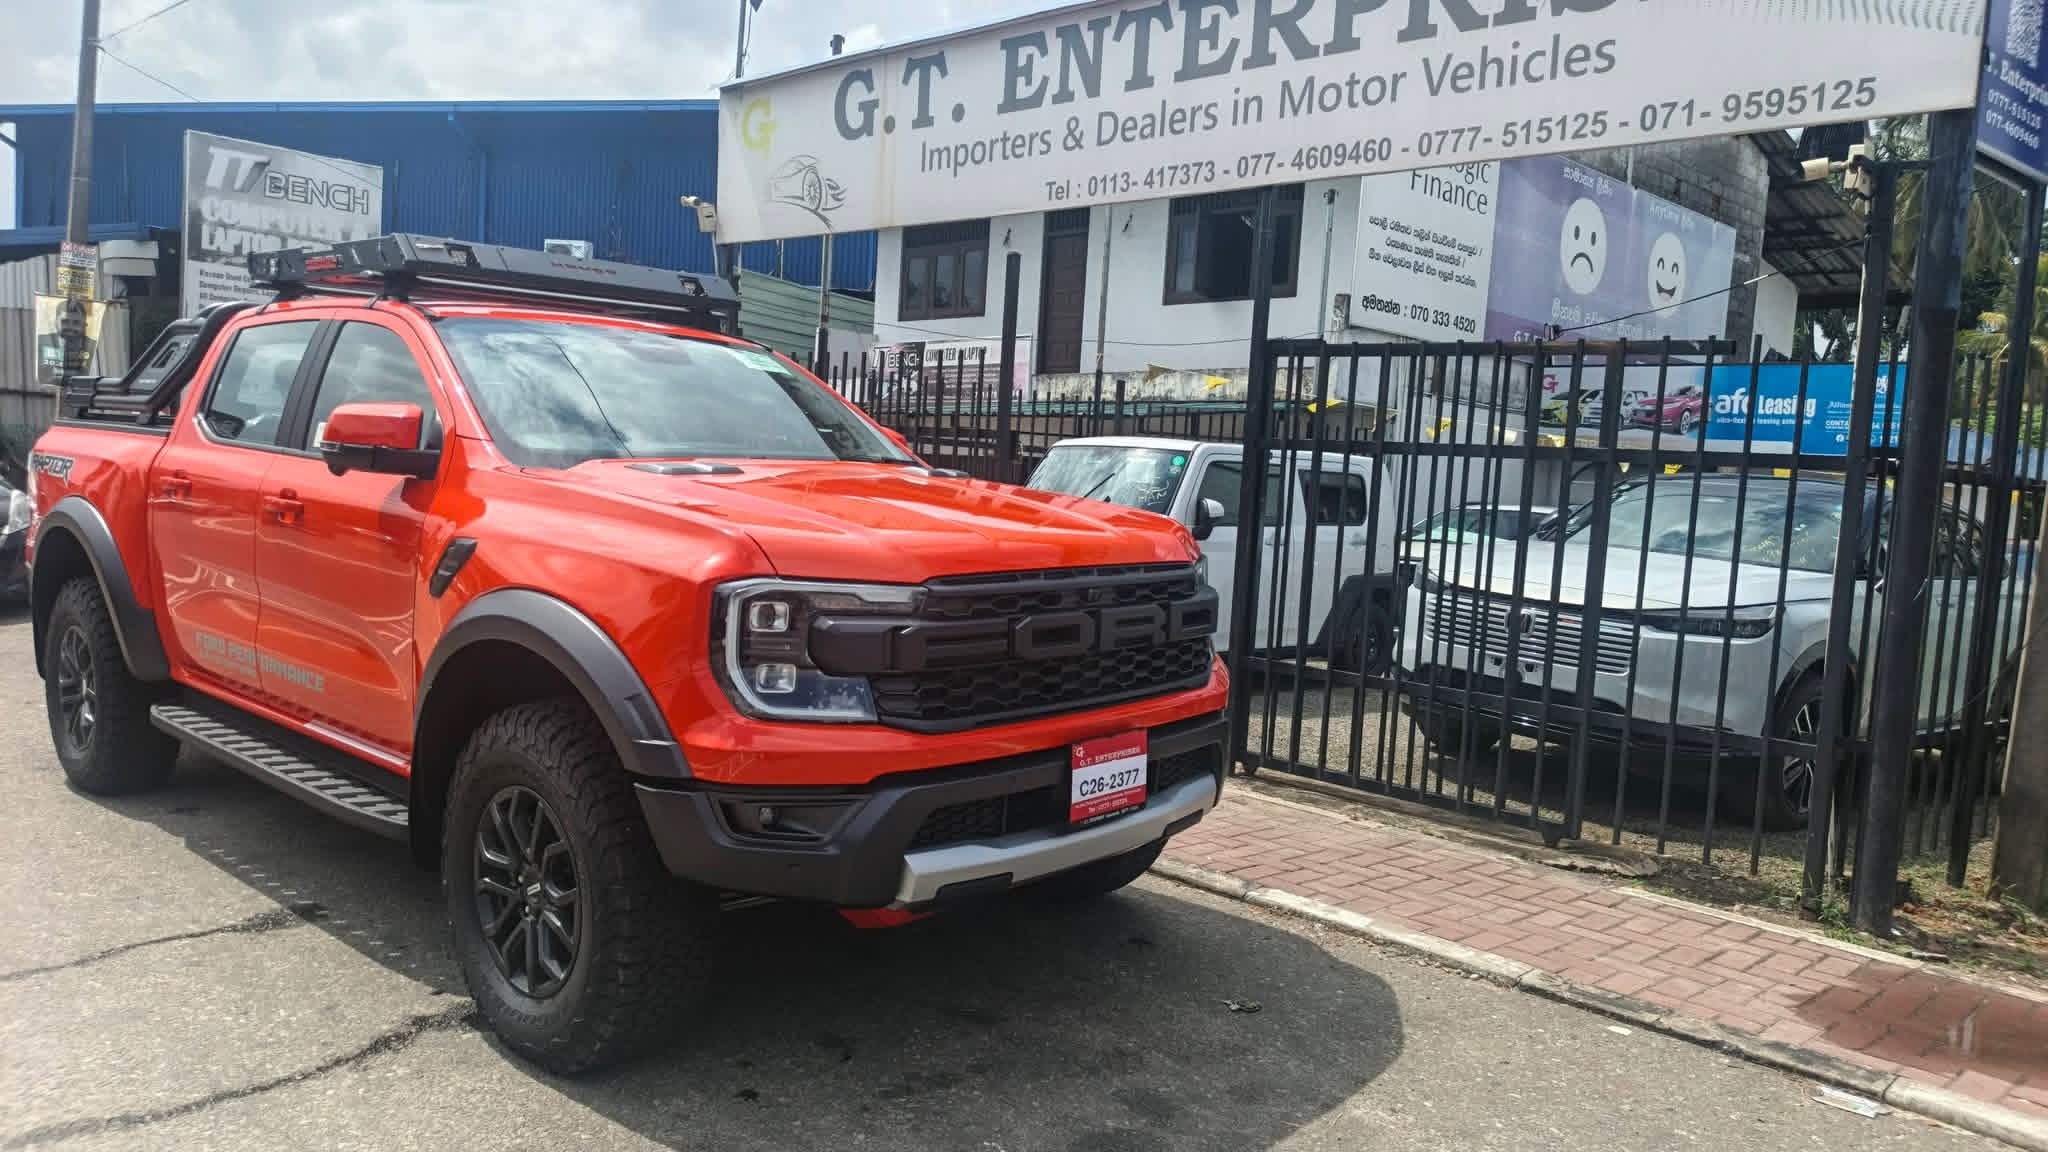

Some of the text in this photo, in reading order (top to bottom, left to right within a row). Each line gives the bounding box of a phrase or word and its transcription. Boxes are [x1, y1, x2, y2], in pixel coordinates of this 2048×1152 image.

[996, 0, 1648, 115] ENTERP
[921, 33, 1617, 177] Importers & Dealers in Motor Vehicles
[1045, 179, 1070, 201] Tel
[1143, 159, 1215, 190] 417373
[1291, 137, 1392, 172] 4609460
[1502, 110, 1609, 148] 515125
[1722, 76, 1877, 123] 9595125
[264, 170, 369, 215] BENCH
[1411, 168, 1488, 215] Finance
[1410, 303, 1429, 323] 070
[1432, 309, 1450, 328] 333
[1453, 314, 1476, 335] 4520
[1758, 394, 1817, 418] Leasig
[896, 592, 1218, 674] FORD
[228, 641, 325, 693] PERFORMANCE
[1079, 767, 1140, 797] C26-2377
